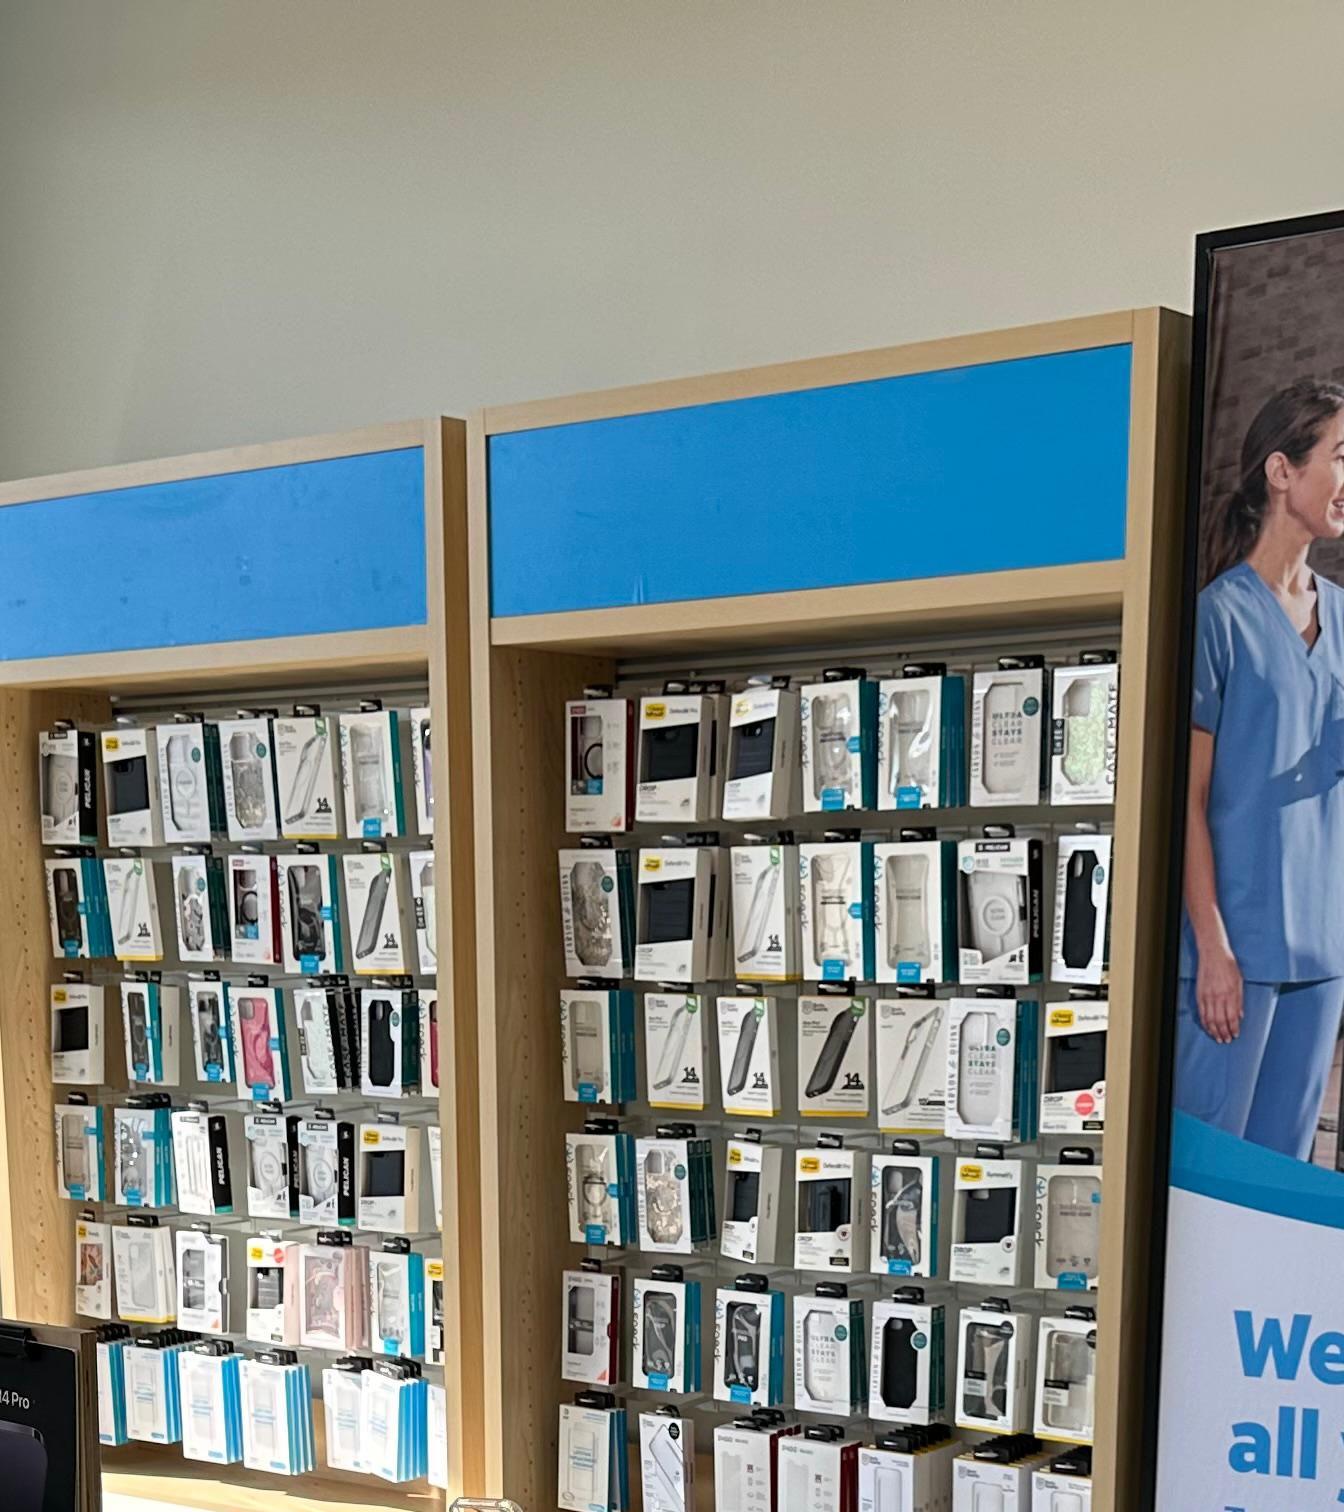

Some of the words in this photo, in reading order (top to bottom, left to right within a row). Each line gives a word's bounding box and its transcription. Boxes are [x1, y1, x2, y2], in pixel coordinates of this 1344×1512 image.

[343, 1157, 351, 1197] PELICAN
[11, 1391, 31, 1410] Pro
[1227, 1405, 1321, 1481] all
